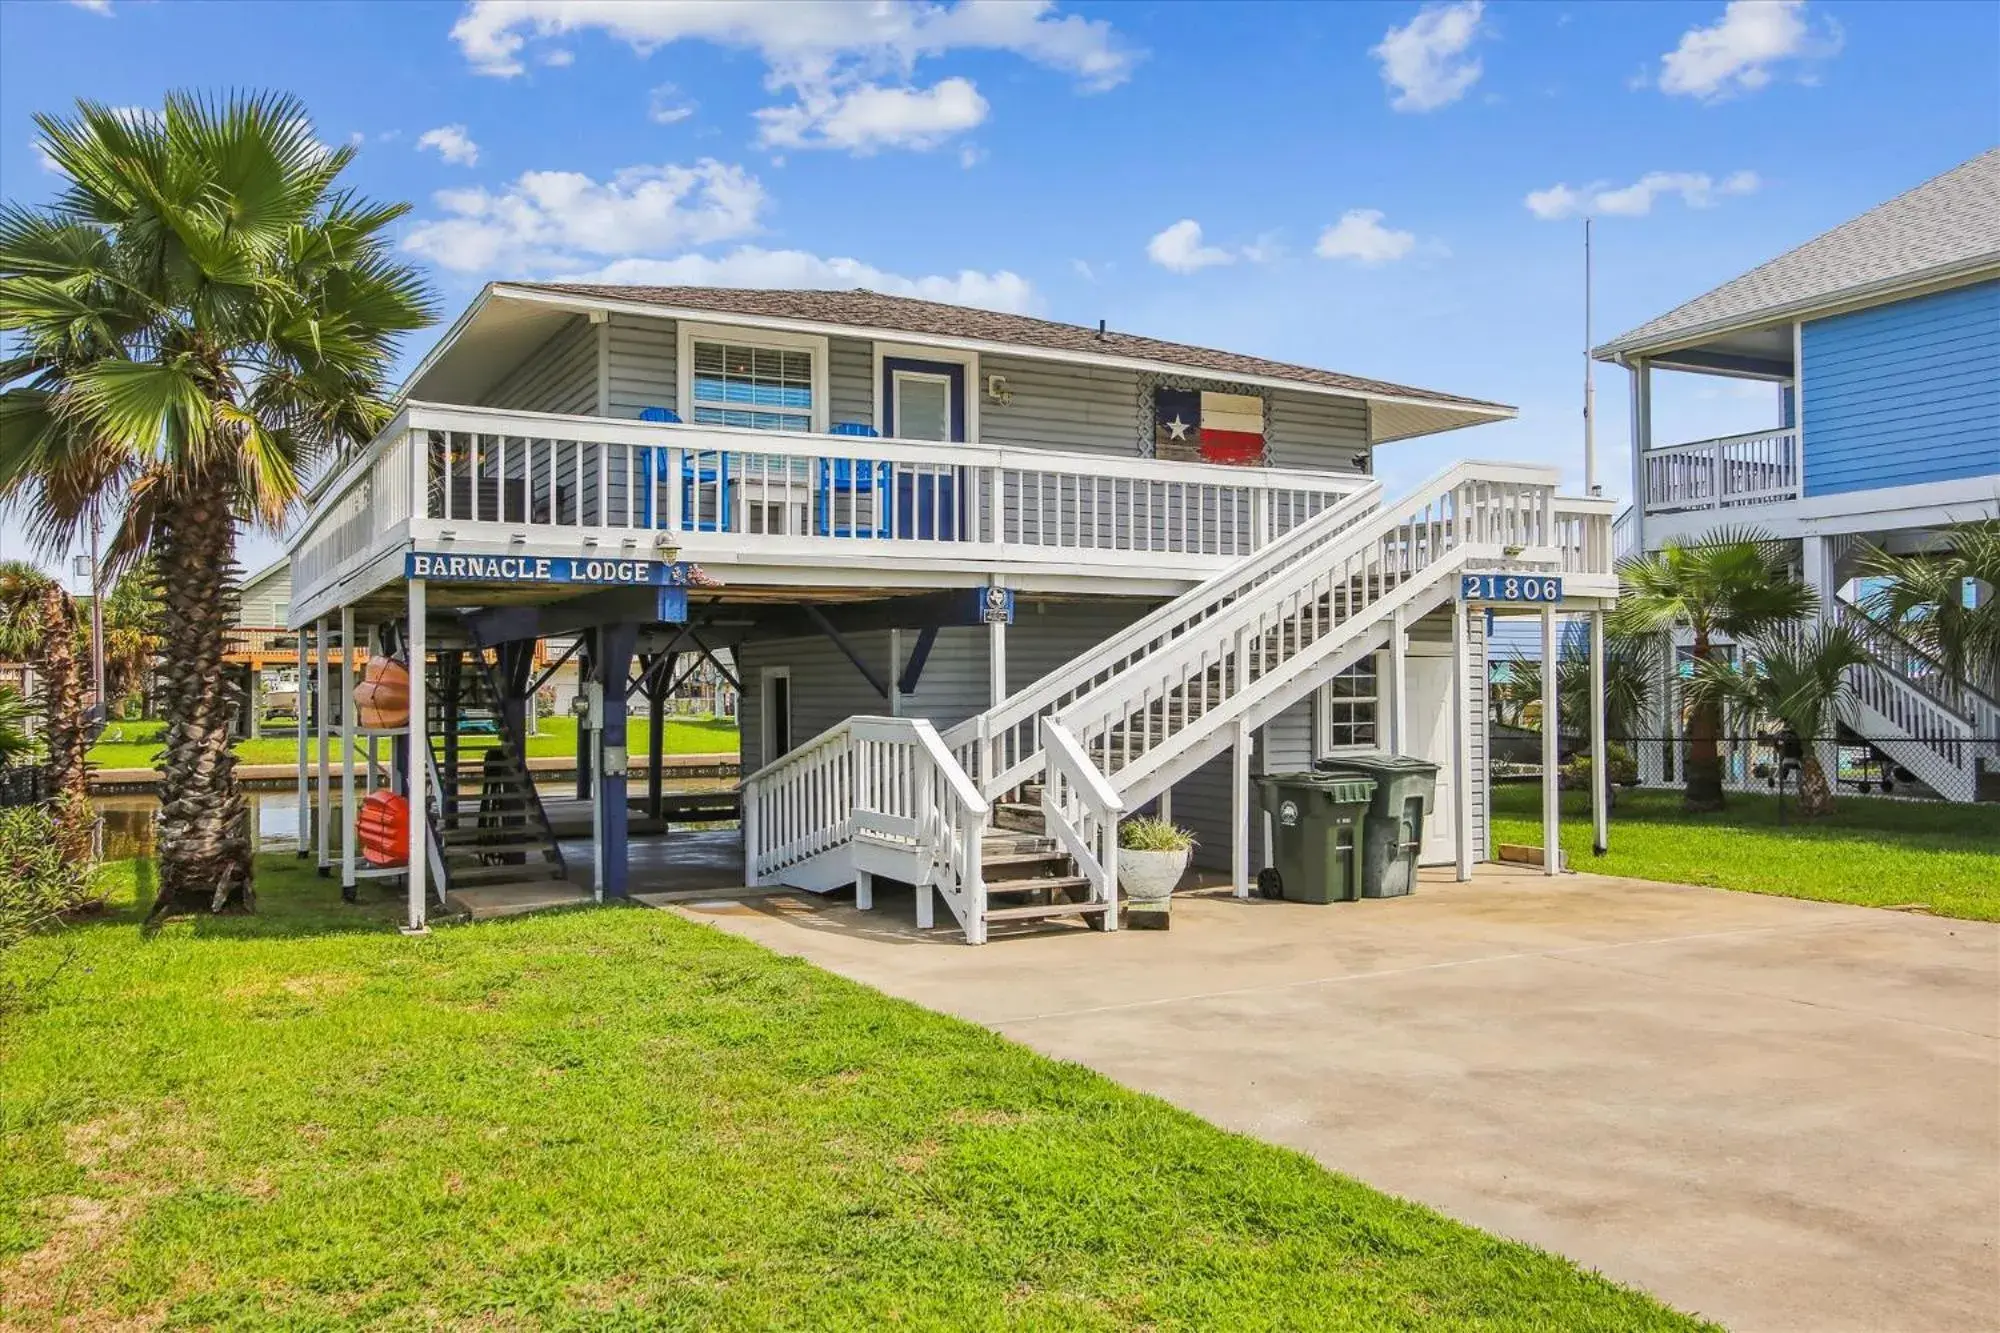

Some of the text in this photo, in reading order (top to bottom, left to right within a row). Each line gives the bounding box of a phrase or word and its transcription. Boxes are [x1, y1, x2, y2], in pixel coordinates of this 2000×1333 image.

[414, 555, 649, 581] BARNACLE LODGE
[1467, 577, 1557, 600] 21806
